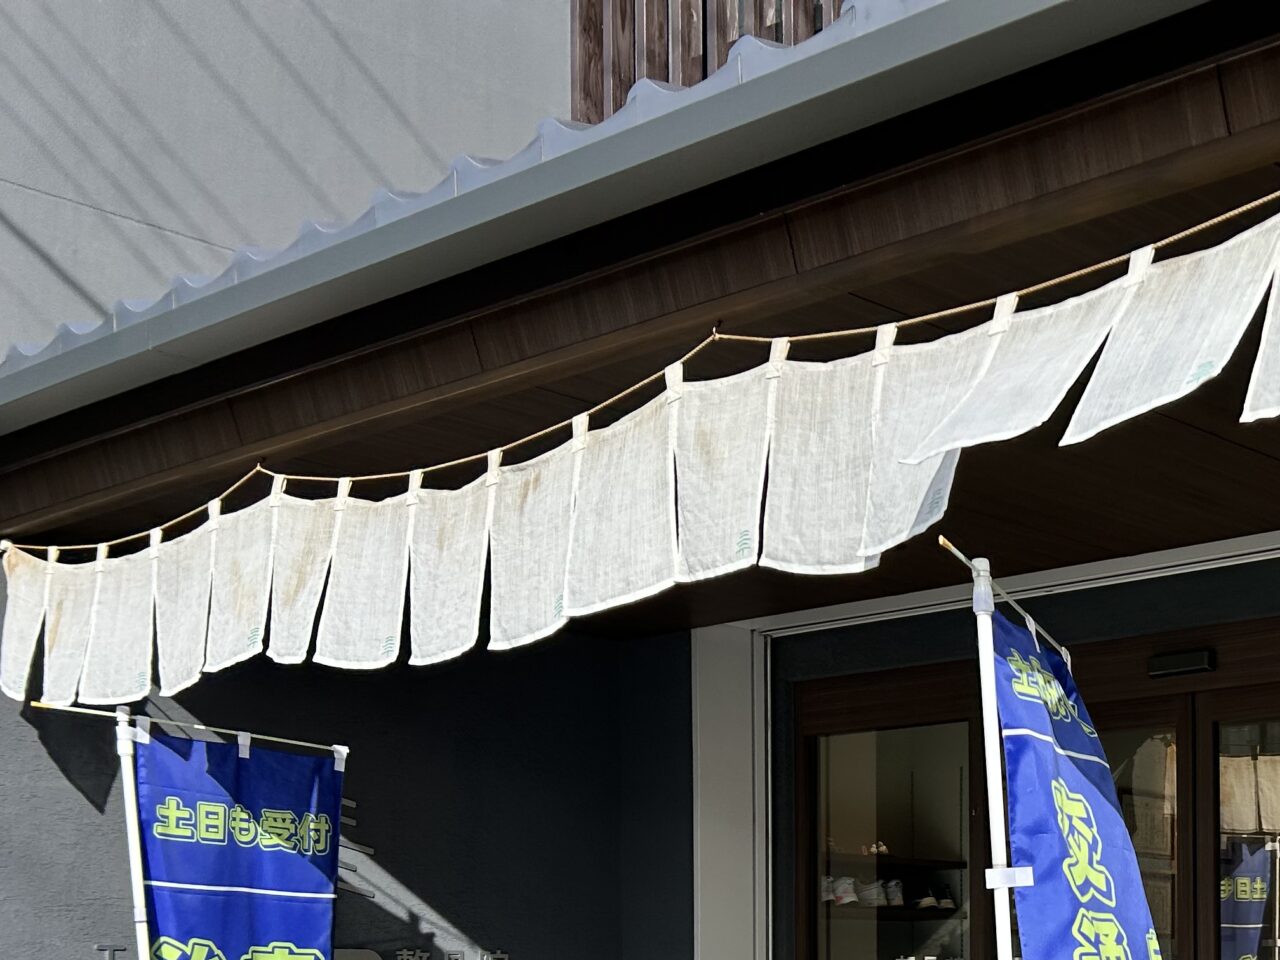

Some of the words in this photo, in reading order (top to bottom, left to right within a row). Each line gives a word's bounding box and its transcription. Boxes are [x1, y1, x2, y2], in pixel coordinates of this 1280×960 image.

[153, 797, 332, 855] 土日も受付
